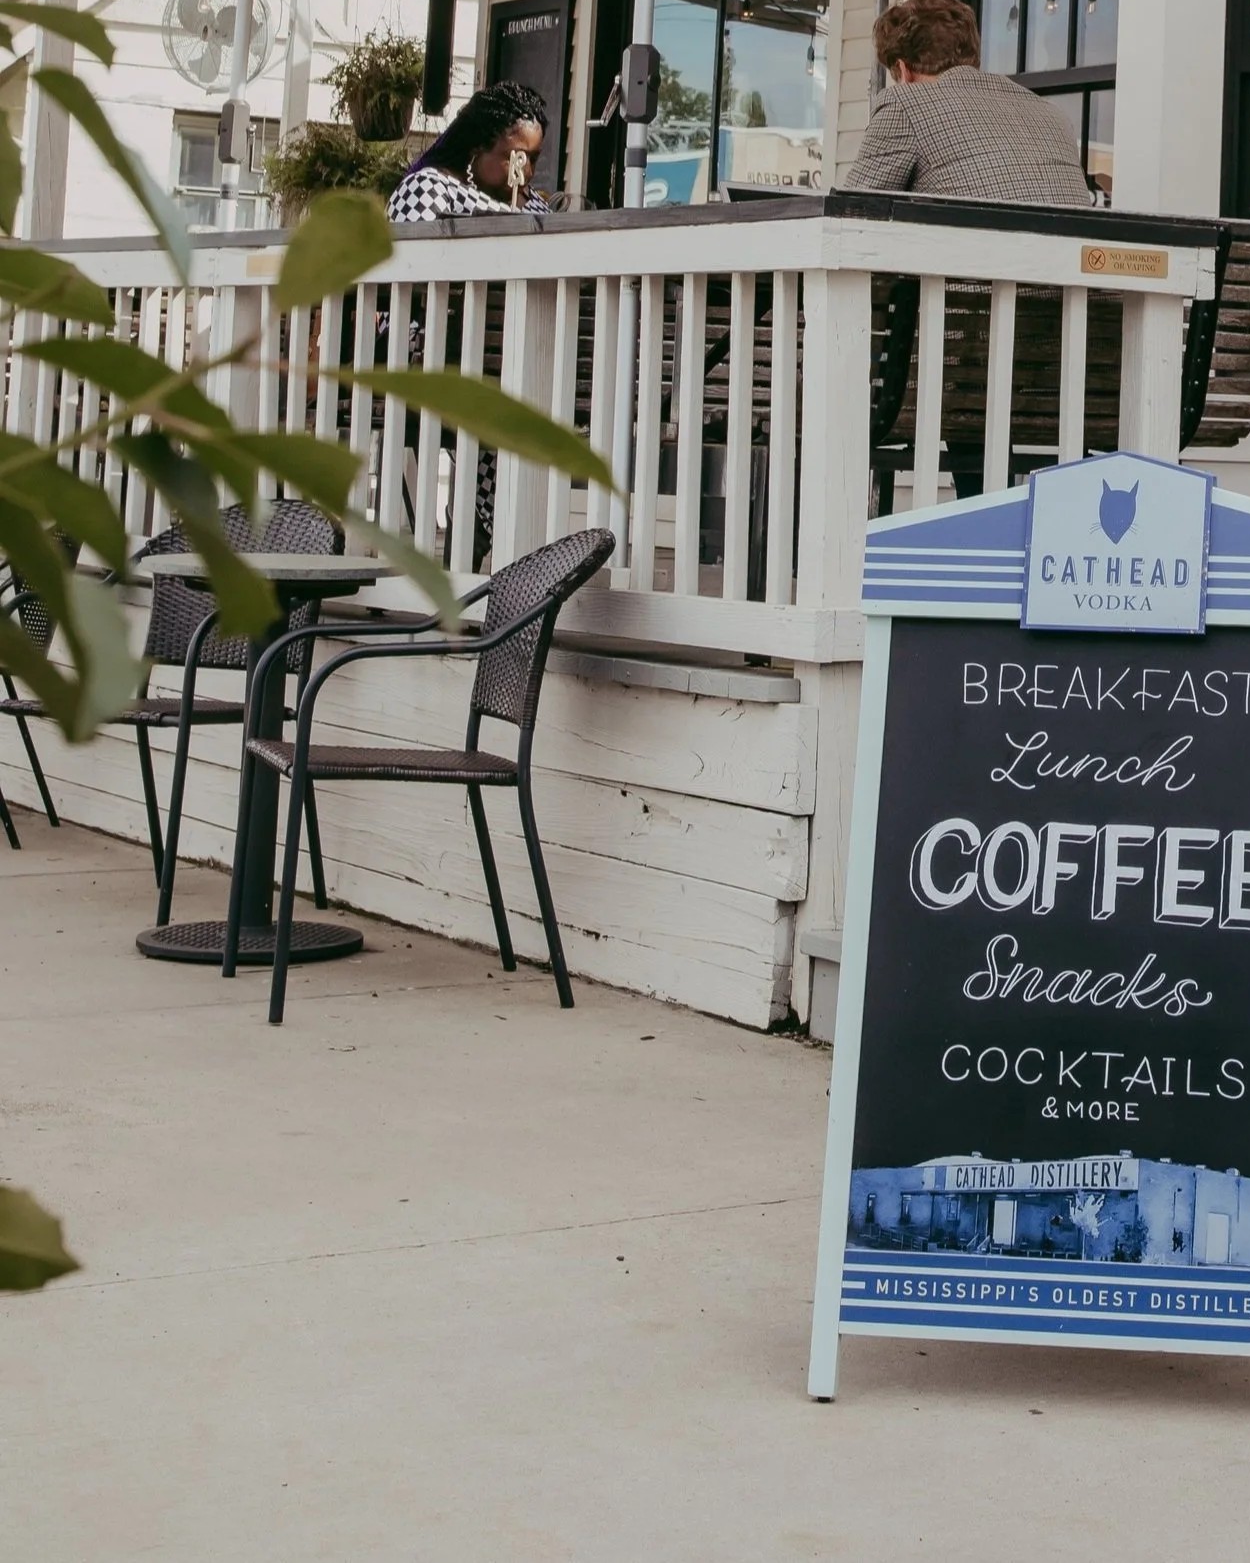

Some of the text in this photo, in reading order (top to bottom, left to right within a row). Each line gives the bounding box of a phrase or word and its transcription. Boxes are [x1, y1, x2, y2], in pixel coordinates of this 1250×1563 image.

[1110, 253, 1161, 264] NO SMOKING
[1113, 262, 1156, 272] OR VAPING
[1041, 555, 1190, 588] CATHEAD
[1073, 594, 1153, 612] VODKA
[991, 731, 1196, 792] Lunch
[962, 934, 1213, 1016] Snacks
[941, 1044, 1246, 1100] COCKTAILS
[956, 1161, 1123, 1188] CATHEAD DISTILLERY
[876, 1278, 1039, 1302] MISSISSIPPI'S
[1052, 1287, 1138, 1307] OLDEST
